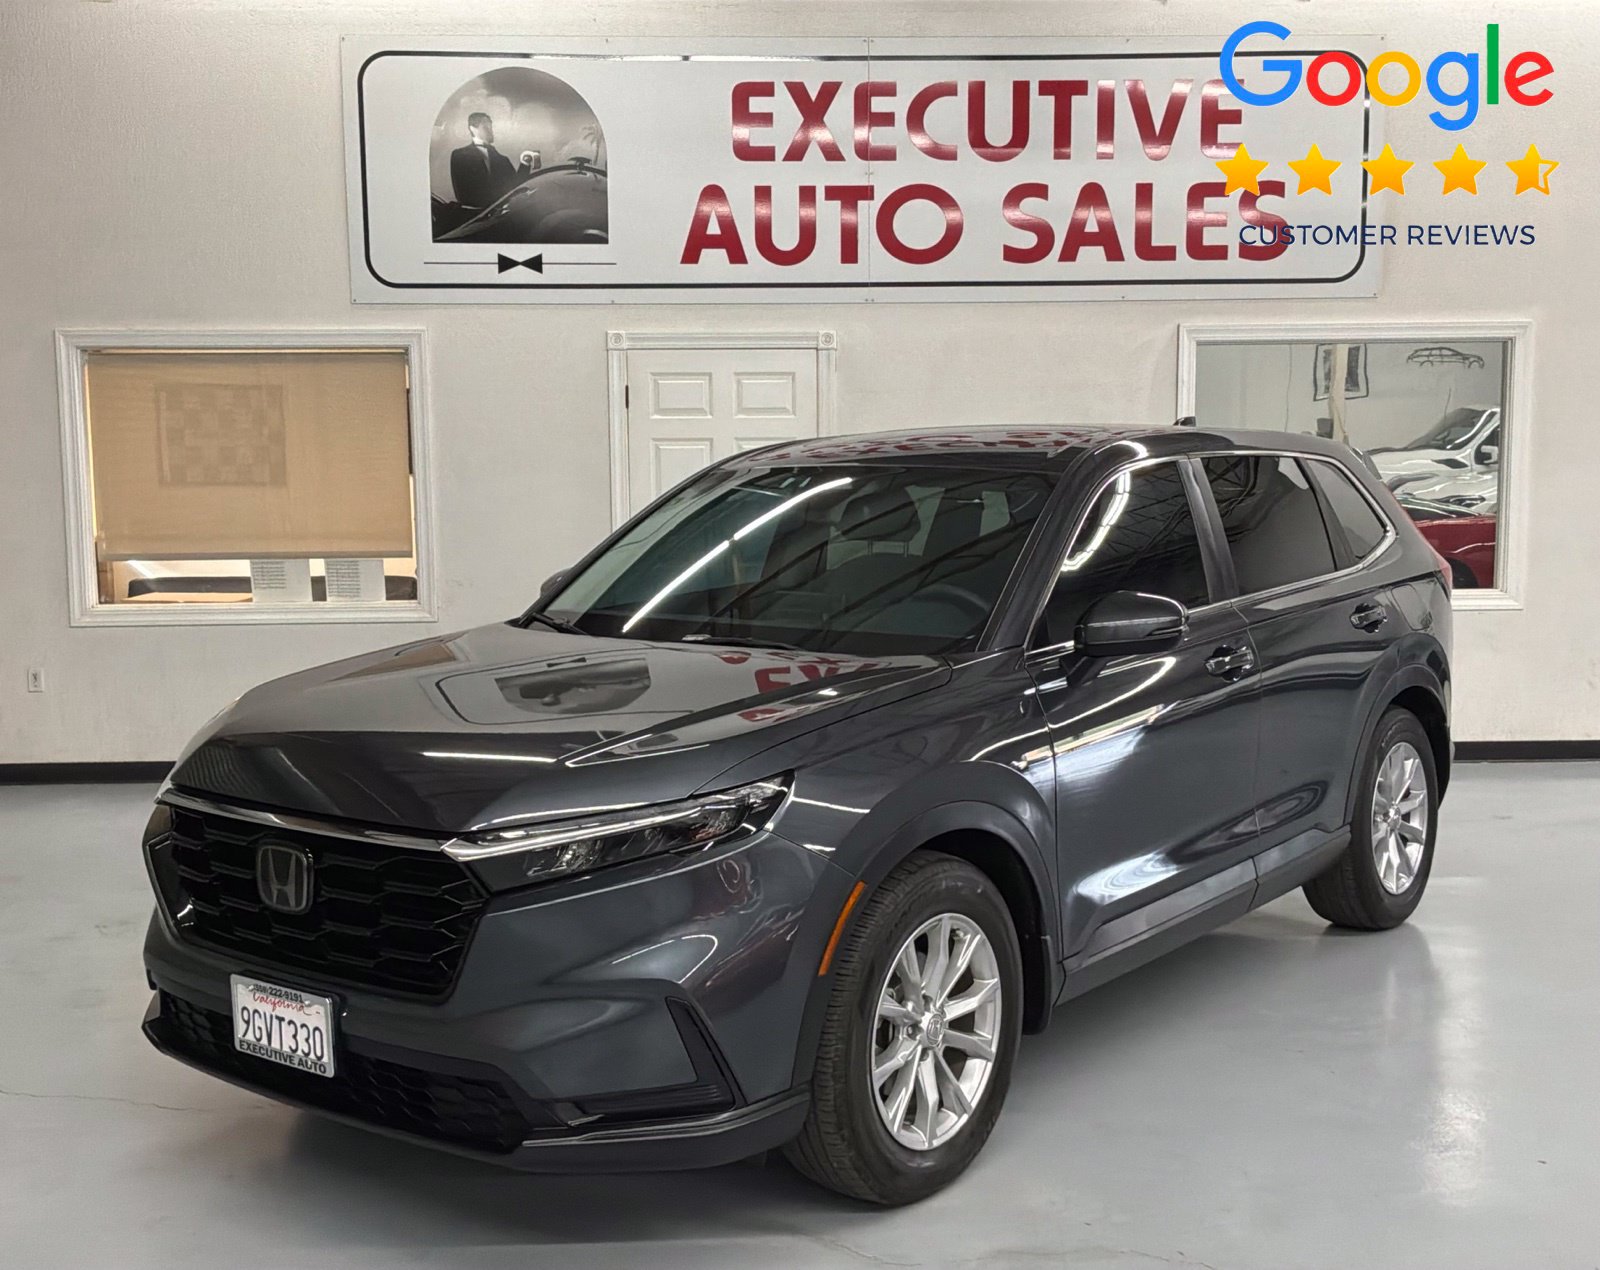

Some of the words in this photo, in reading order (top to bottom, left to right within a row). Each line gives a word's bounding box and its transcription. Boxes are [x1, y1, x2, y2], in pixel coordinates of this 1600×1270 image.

[732, 79, 1246, 161] EXECUTIVE
[681, 183, 964, 266] AUTO
[1002, 180, 1290, 262] SALES
[240, 1039, 296, 1065] EXECUTIVE
[297, 1059, 327, 1075] AUTO
[241, 1006, 324, 1061] 9GVT330
